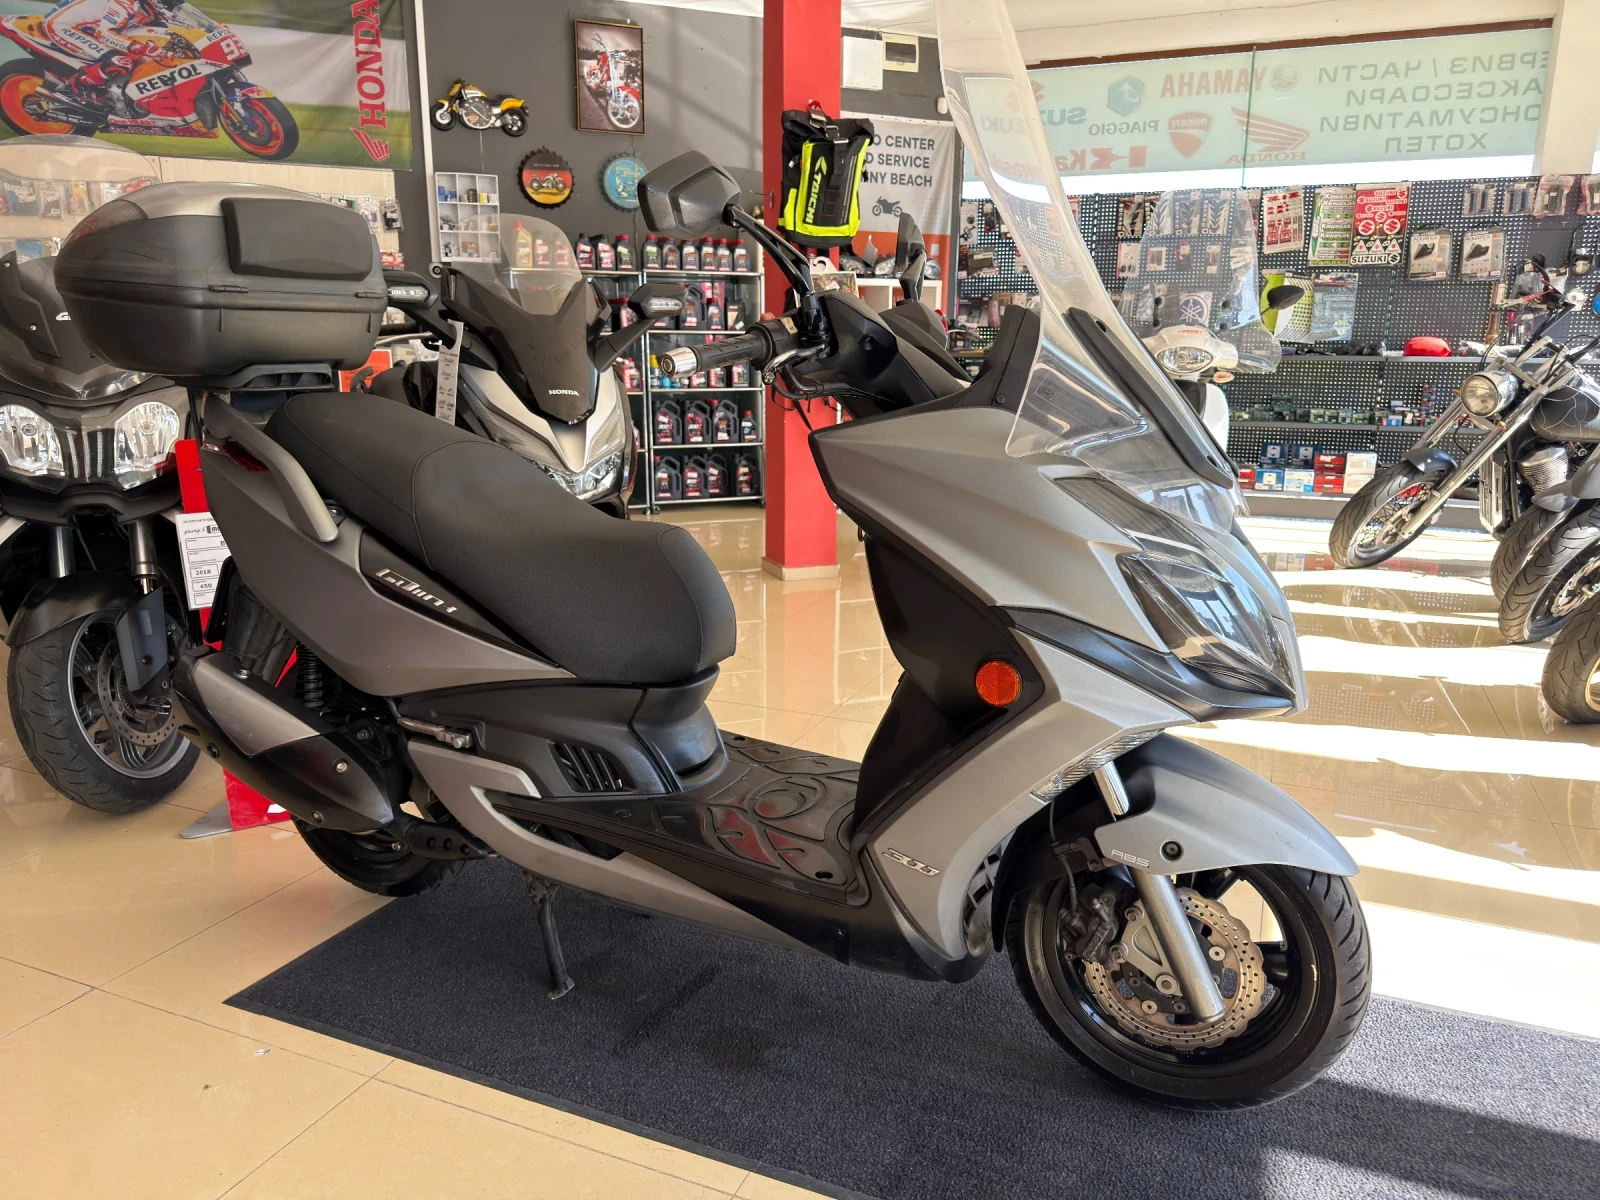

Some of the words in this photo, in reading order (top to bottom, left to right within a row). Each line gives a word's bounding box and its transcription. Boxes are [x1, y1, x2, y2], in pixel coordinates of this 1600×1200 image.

[220, 38, 247, 60] 93
[351, 0, 387, 129] HONDA
[135, 64, 201, 94] REPSOL
[885, 135, 935, 151] CENTER
[878, 153, 930, 169] SERVICE
[891, 173, 932, 187] BEACH
[805, 174, 821, 223] TAICHI
[1351, 255, 1387, 264] SUZUKI
[1111, 849, 1149, 868] ABS
